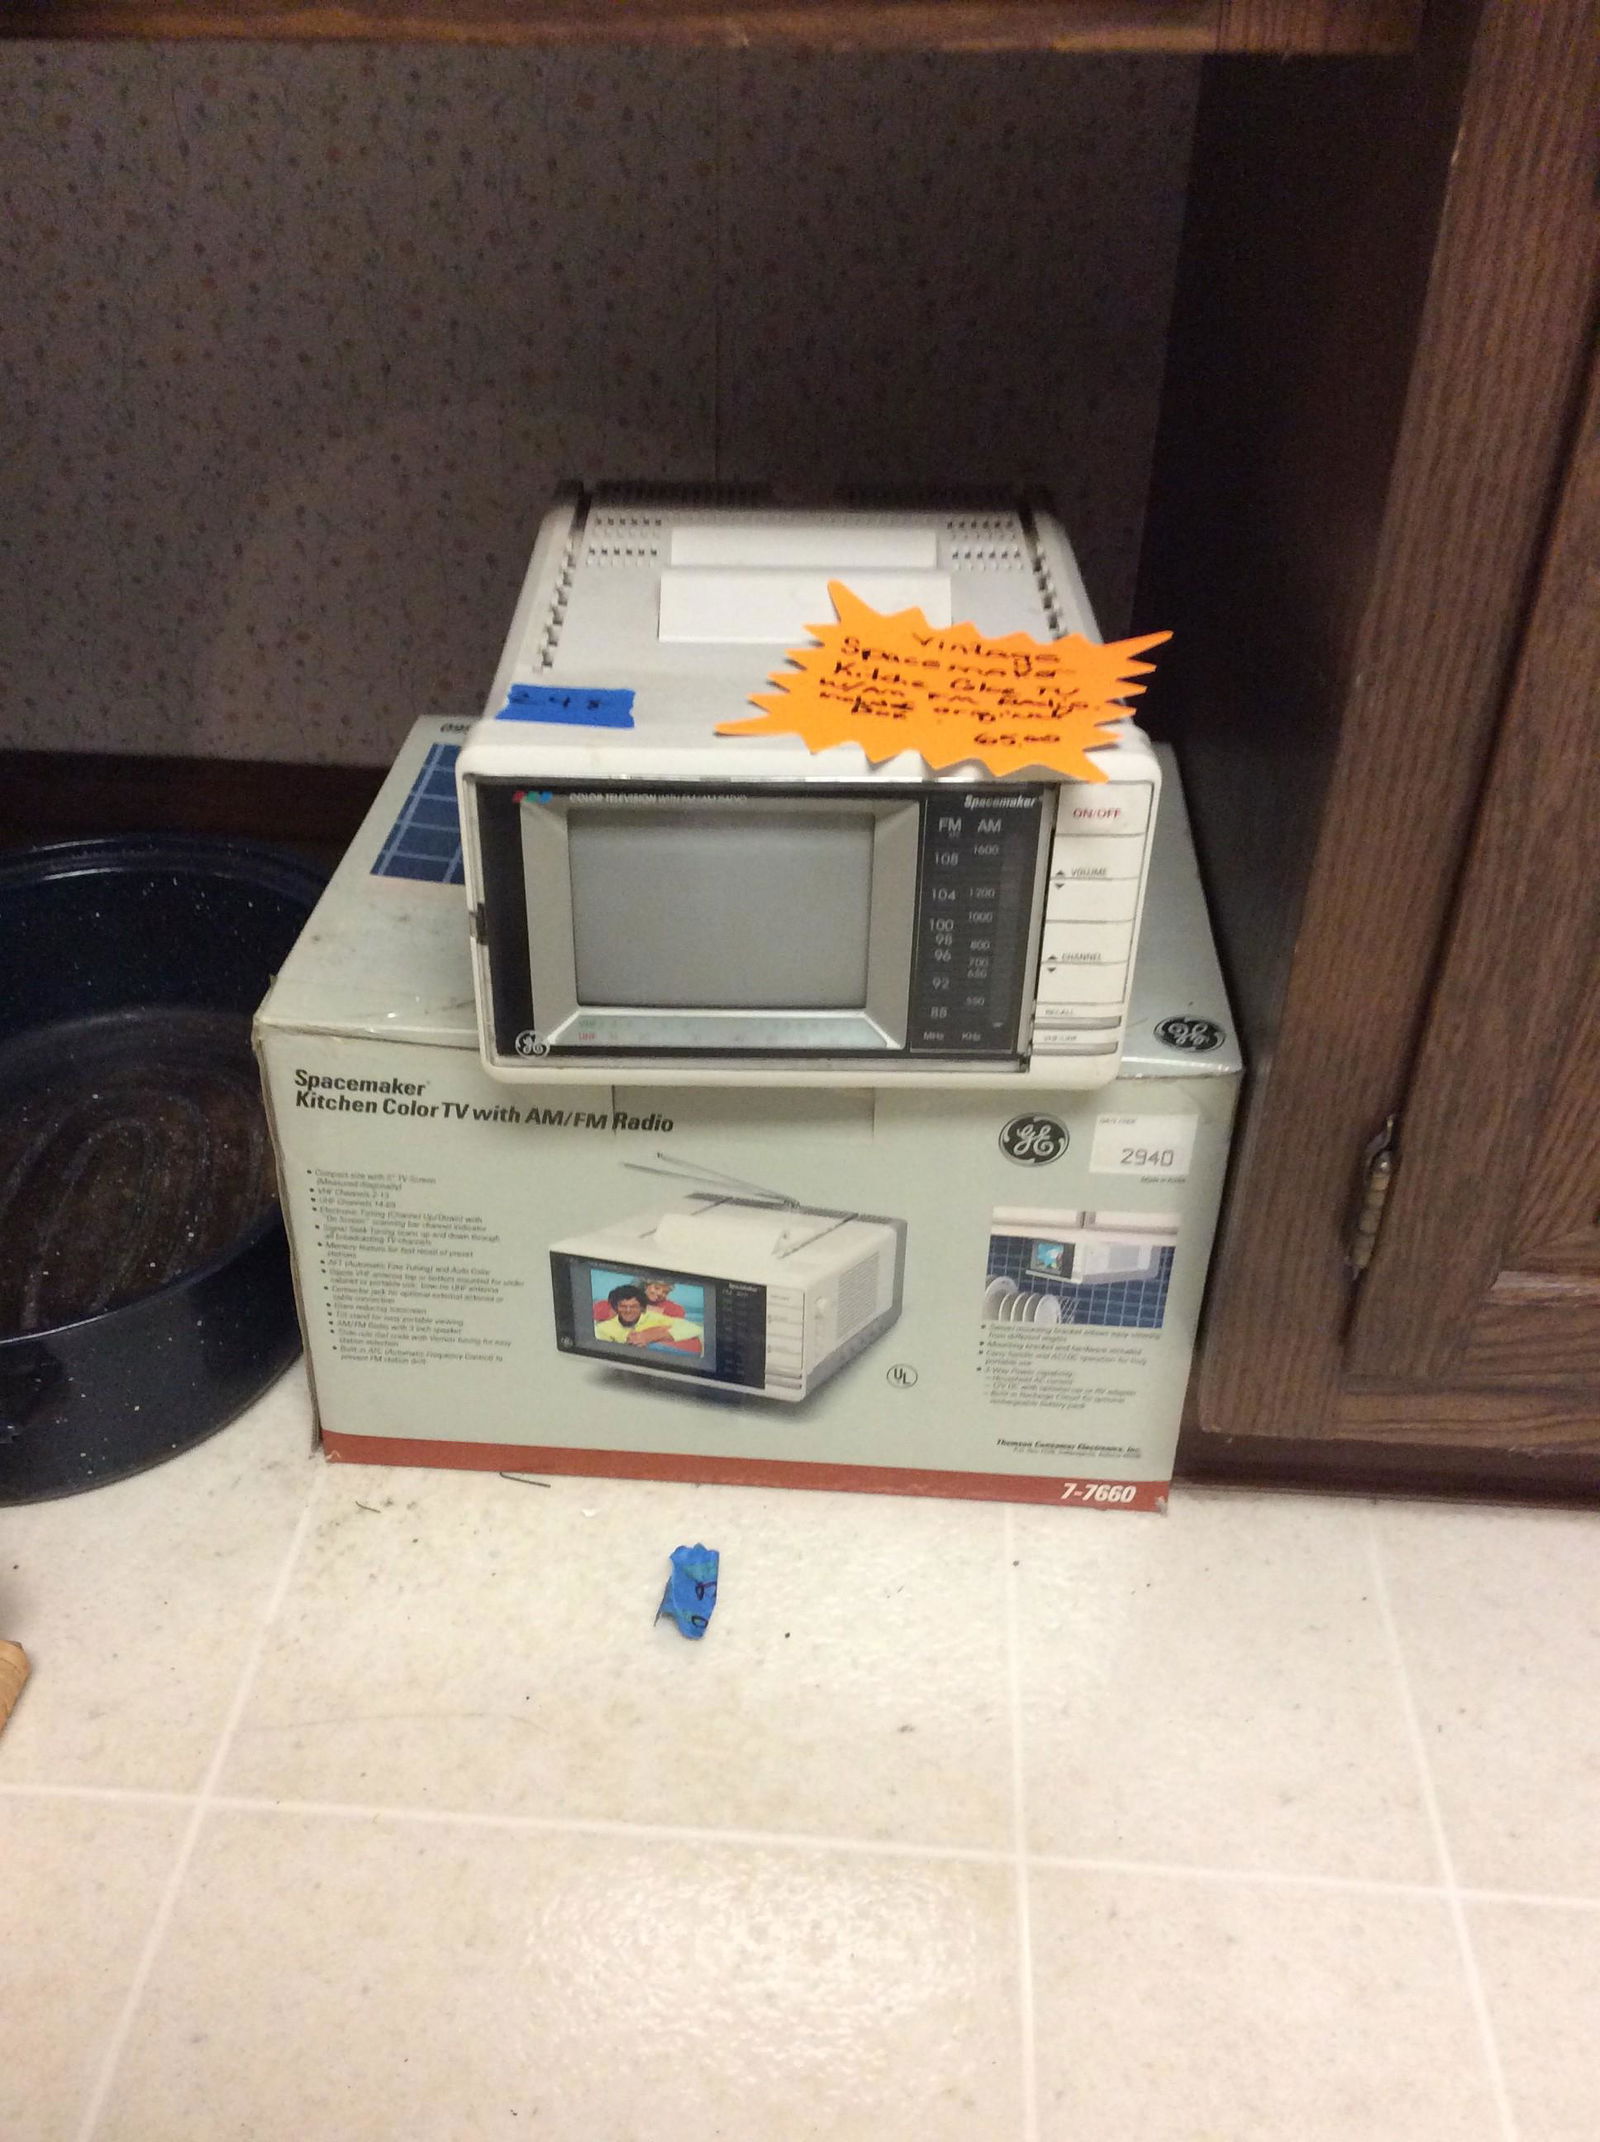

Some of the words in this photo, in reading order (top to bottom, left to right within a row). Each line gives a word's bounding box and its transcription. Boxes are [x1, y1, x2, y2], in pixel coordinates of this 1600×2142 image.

[964, 795, 1036, 810] Spacemaker
[1072, 807, 1121, 820] ON/OFF
[939, 817, 962, 832] FM
[977, 819, 1002, 834] AM
[935, 852, 959, 866] 108
[1071, 867, 1107, 878] VOLUME
[932, 887, 956, 901] 104
[968, 910, 993, 923] 1000
[930, 918, 954, 932] 100
[934, 948, 952, 962] 96
[295, 1068, 427, 1096] Spacemaker
[296, 1090, 378, 1115] Kitchen
[382, 1097, 439, 1118] Color
[442, 1102, 469, 1120] TV
[472, 1104, 521, 1125] with
[525, 1107, 608, 1130] AM/FM
[612, 1111, 675, 1134] Radio
[1120, 1148, 1175, 1168] 2940
[1060, 1482, 1137, 1503] 7-7660
